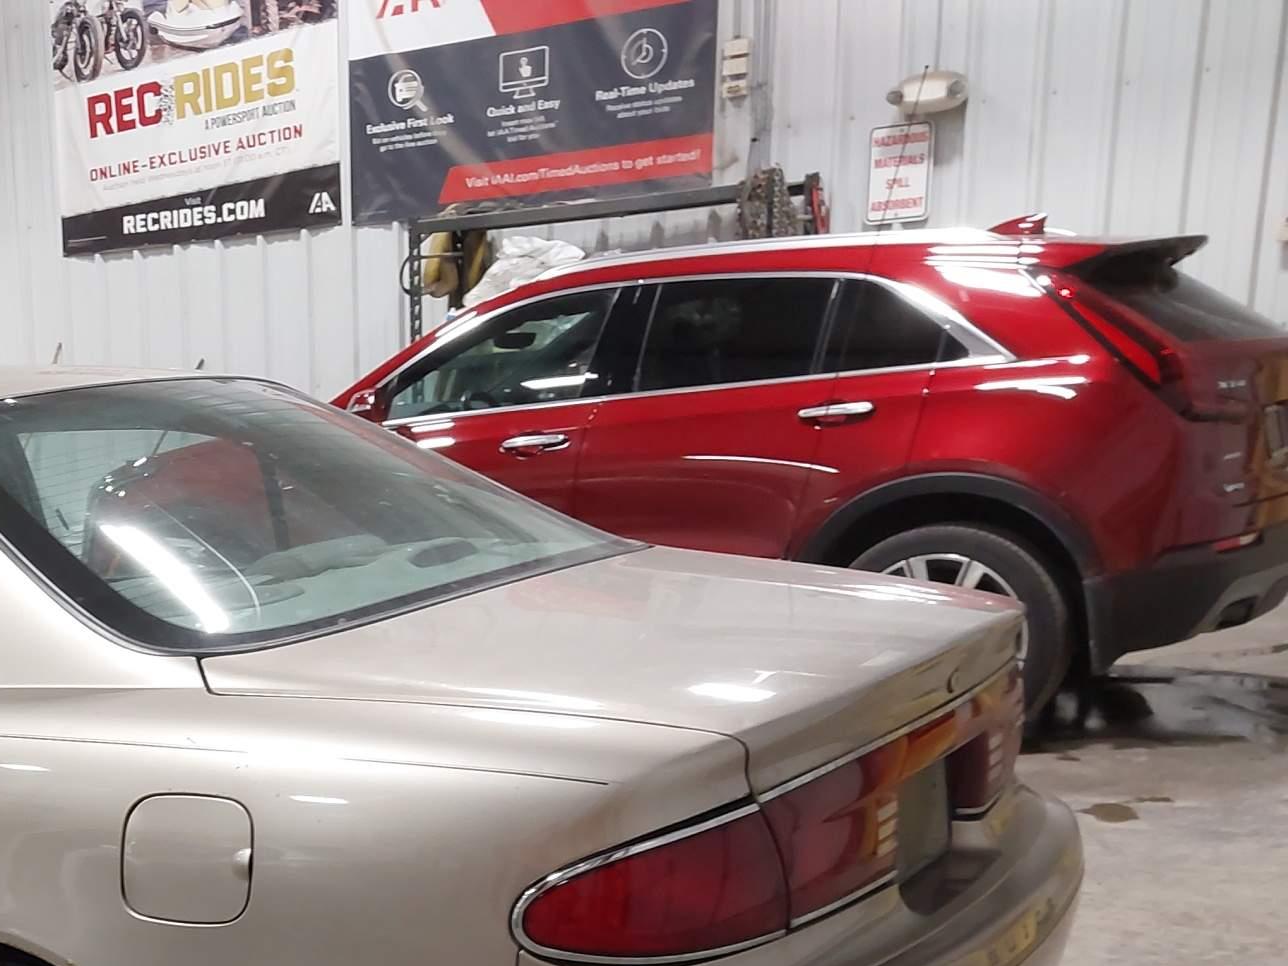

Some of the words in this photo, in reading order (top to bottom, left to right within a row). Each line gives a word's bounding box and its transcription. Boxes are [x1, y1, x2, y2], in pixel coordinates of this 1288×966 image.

[87, 81, 163, 139] REC
[174, 48, 296, 120] RIDES
[648, 79, 695, 94] Updates
[263, 100, 296, 117] AUCTION
[487, 104, 516, 117] Quick
[517, 100, 536, 113] and
[537, 99, 561, 110] Easy
[90, 140, 231, 182] ONLINE-EXCLUSIVE
[235, 124, 303, 151] AUCTION
[465, 177, 489, 188] Visit
[621, 160, 633, 169] to
[122, 198, 266, 235] RECRIDES.COM
